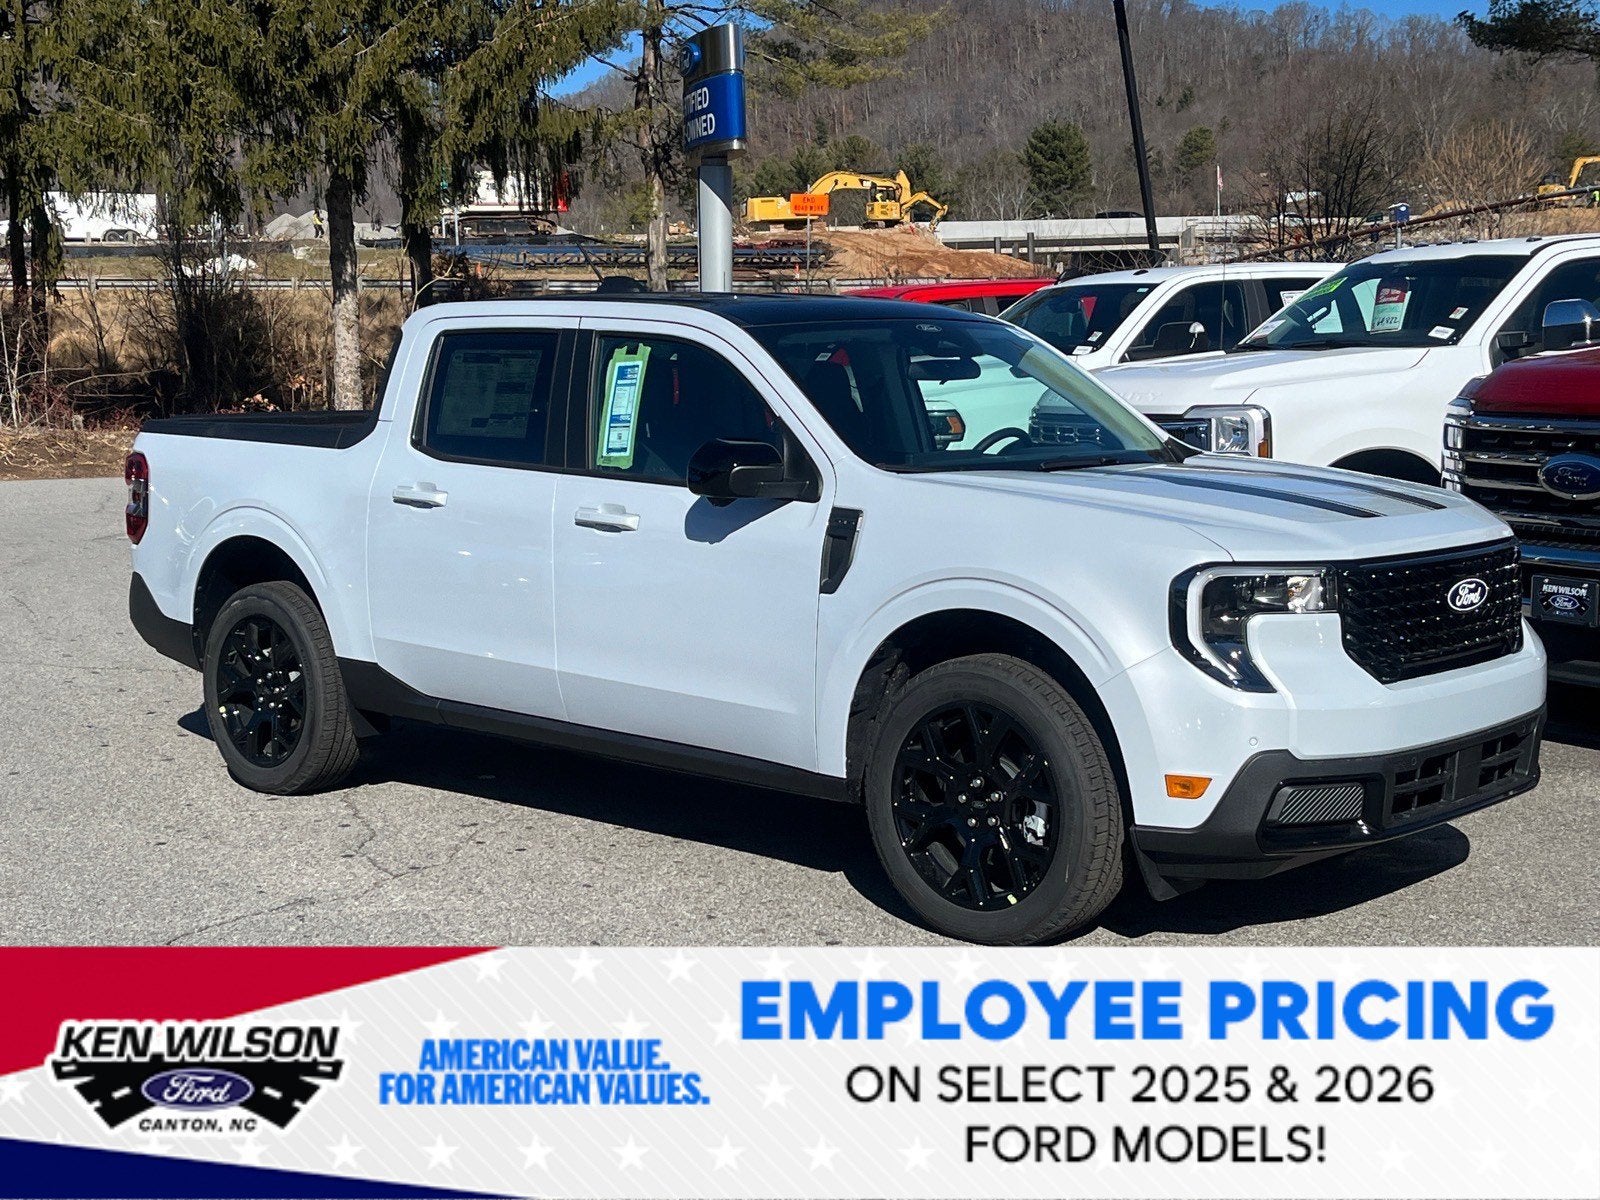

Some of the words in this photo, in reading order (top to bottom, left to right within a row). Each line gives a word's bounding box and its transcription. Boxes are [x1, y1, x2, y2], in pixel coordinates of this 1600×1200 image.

[1455, 583, 1482, 606] Ford
[1542, 584, 1559, 594] KEN
[1558, 585, 1588, 597] WILSON
[1554, 596, 1574, 608] Ford
